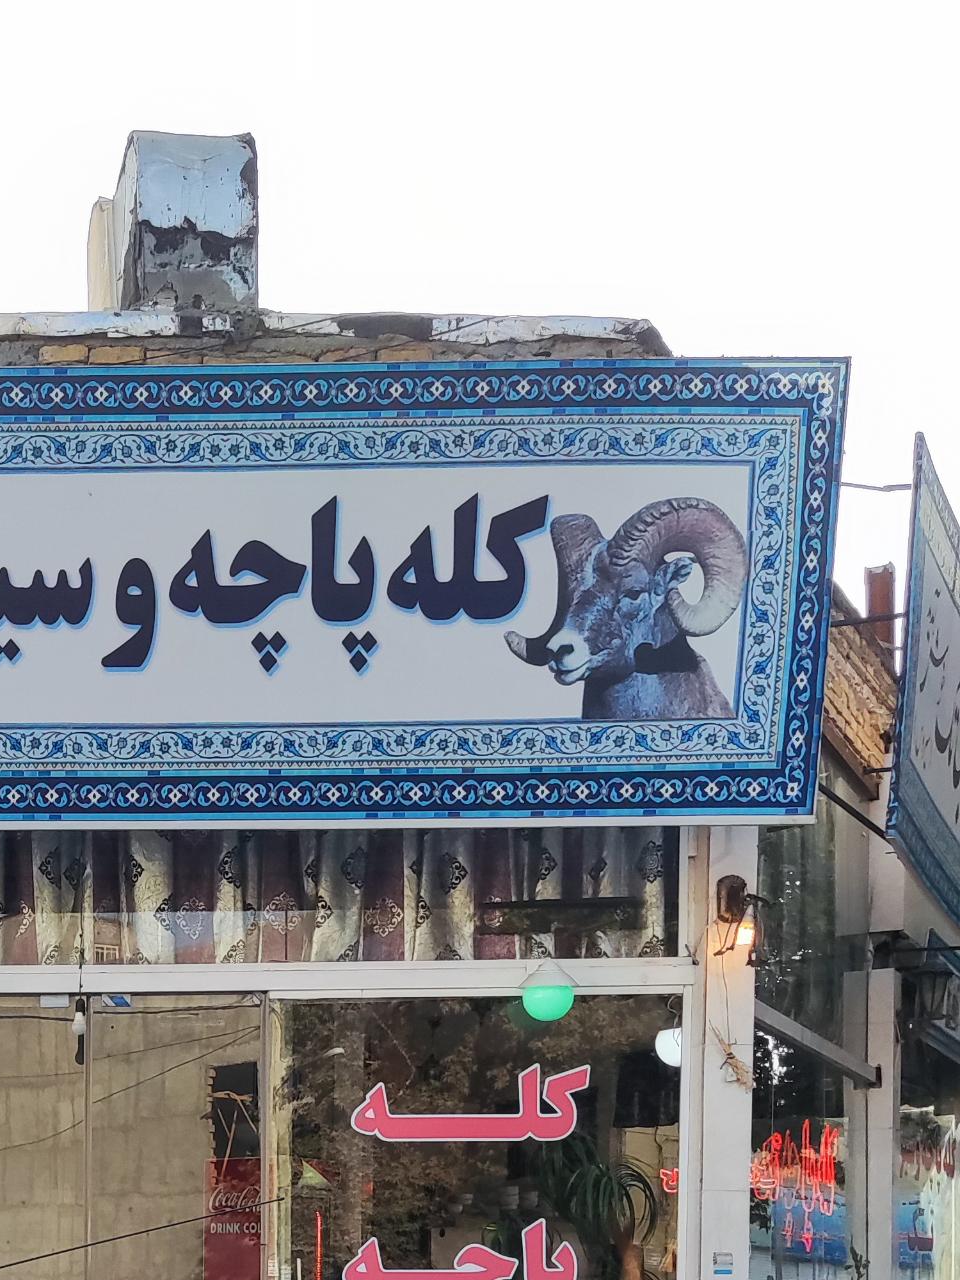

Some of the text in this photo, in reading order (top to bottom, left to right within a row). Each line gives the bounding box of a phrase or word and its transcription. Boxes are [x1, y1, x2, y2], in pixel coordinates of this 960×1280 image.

[101, 557, 156, 670] و
[169, 496, 376, 673] پاچه
[387, 494, 550, 623] کله
[350, 1063, 592, 1142] کله
[210, 1222, 261, 1234] DRINK COL
